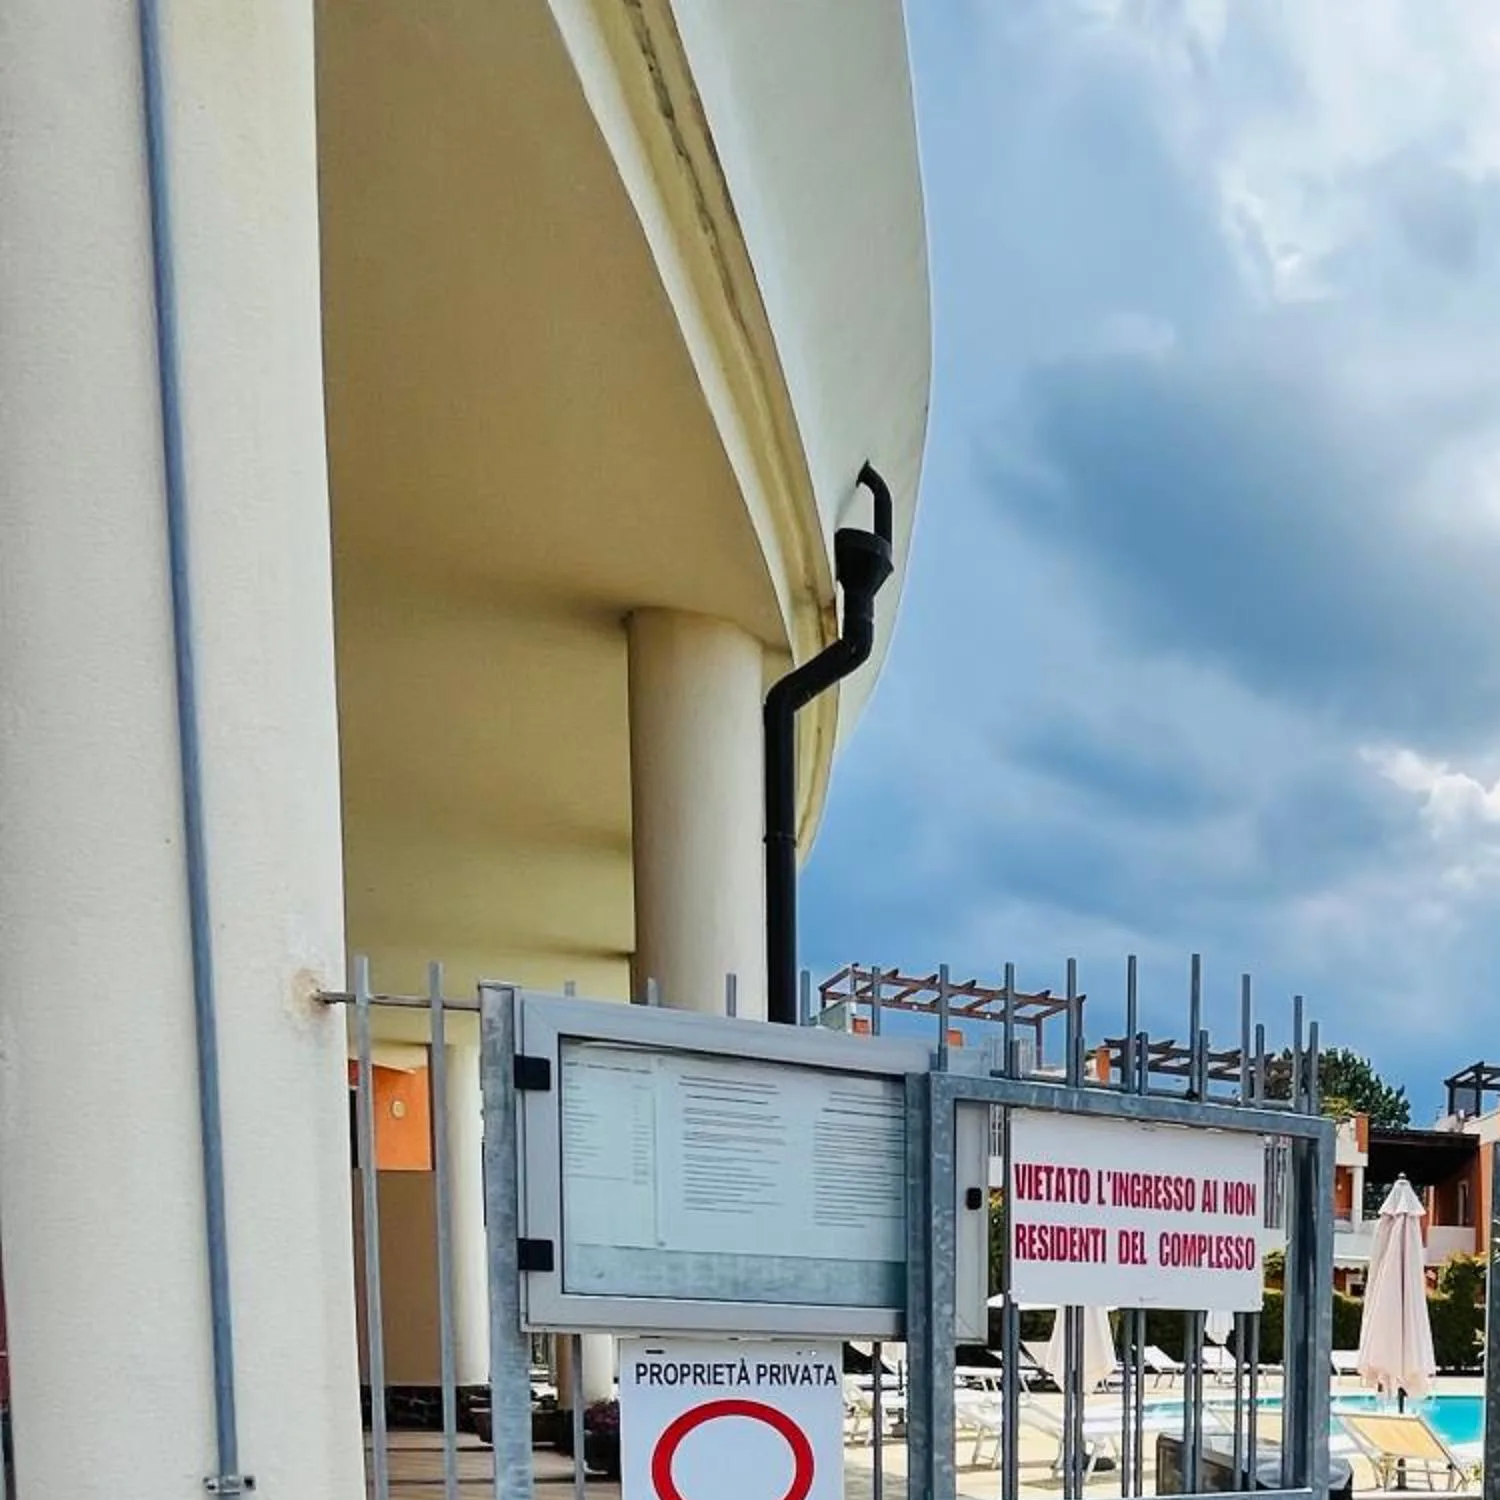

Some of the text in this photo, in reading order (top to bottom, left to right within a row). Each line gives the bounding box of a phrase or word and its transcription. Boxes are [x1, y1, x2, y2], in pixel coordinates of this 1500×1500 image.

[1014, 1163, 1256, 1217] VIETATO L'INGRESSO AI NON
[1015, 1223, 1255, 1271] RESIDENTI DEL COMPLESSO
[635, 1358, 837, 1386] PROPRIETÀ PRIVATA
